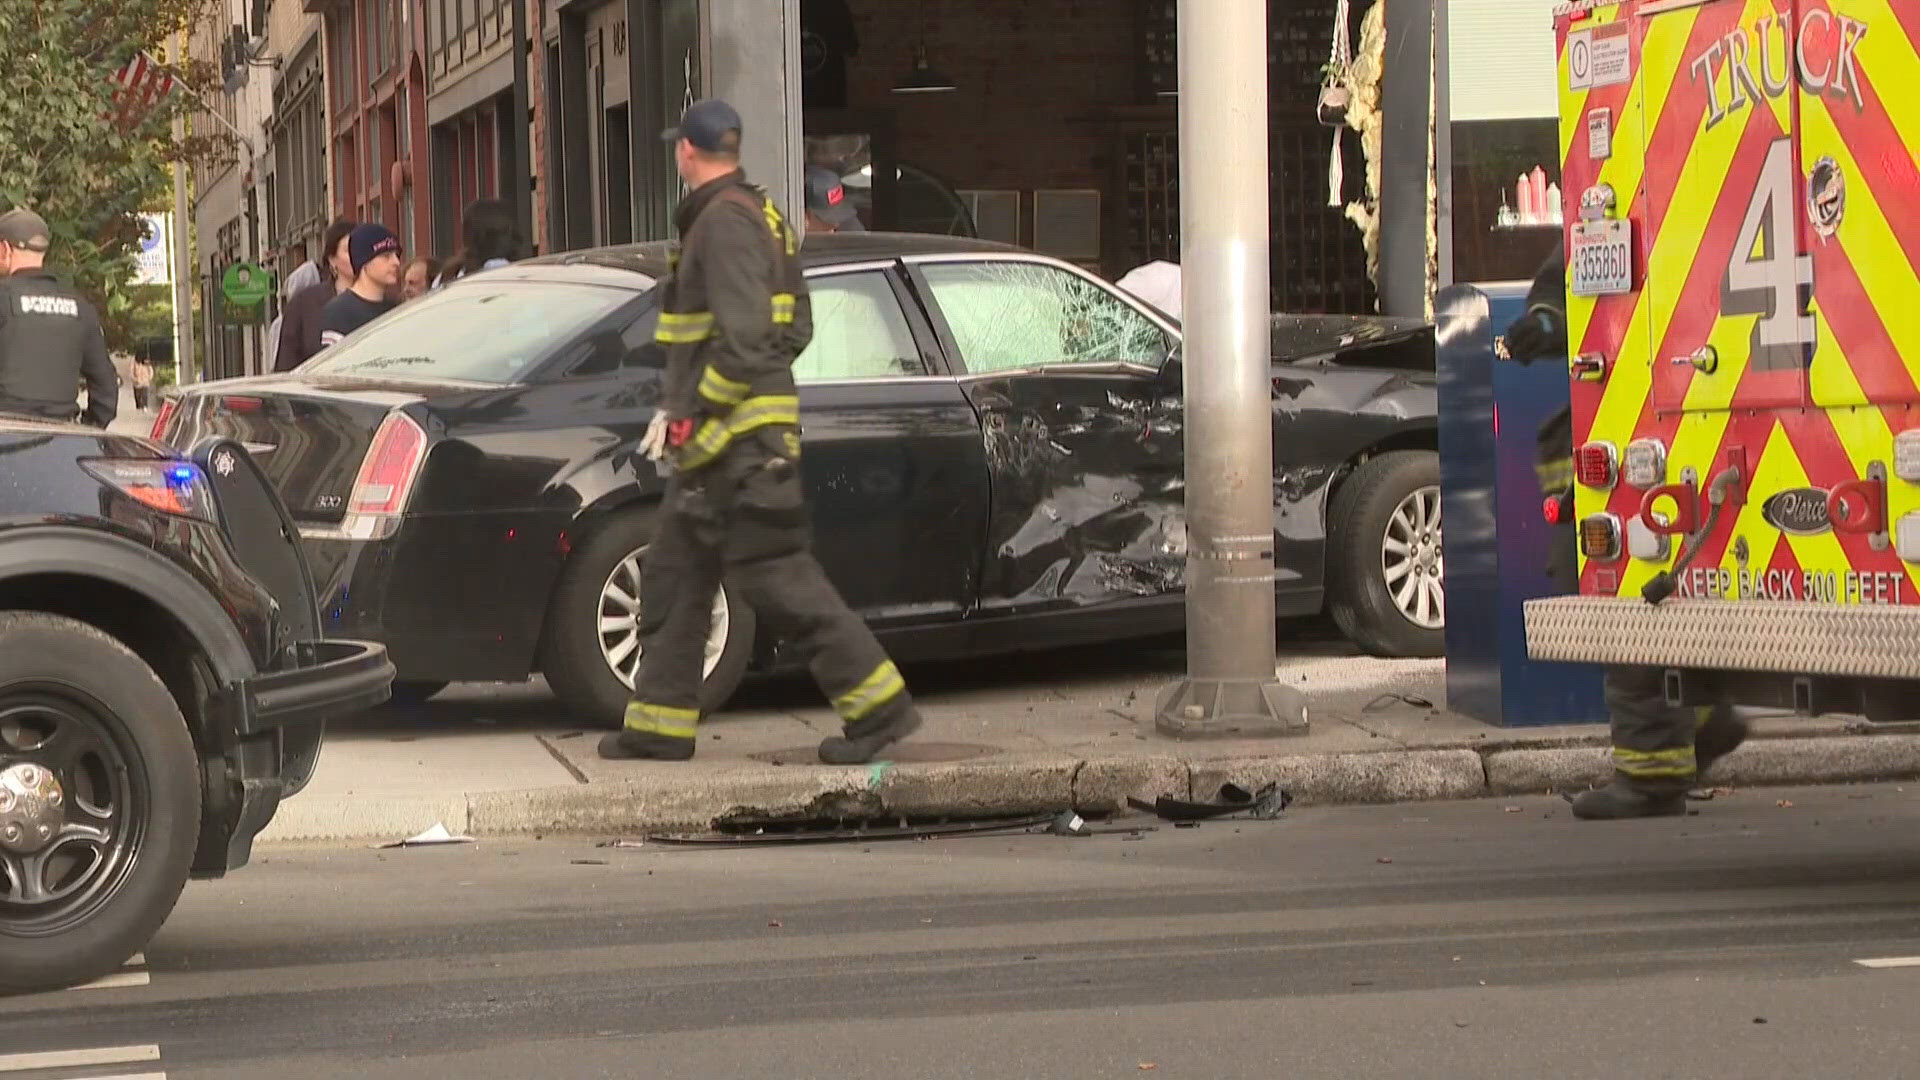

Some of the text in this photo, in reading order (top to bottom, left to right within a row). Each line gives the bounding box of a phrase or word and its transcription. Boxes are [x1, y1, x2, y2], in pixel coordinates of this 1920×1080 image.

[1690, 8, 1868, 130] TRUCK
[1726, 137, 1817, 352] 4
[1779, 492, 1828, 527] Pierce
[1677, 567, 1904, 606] KEEP BACK 500 FEET
